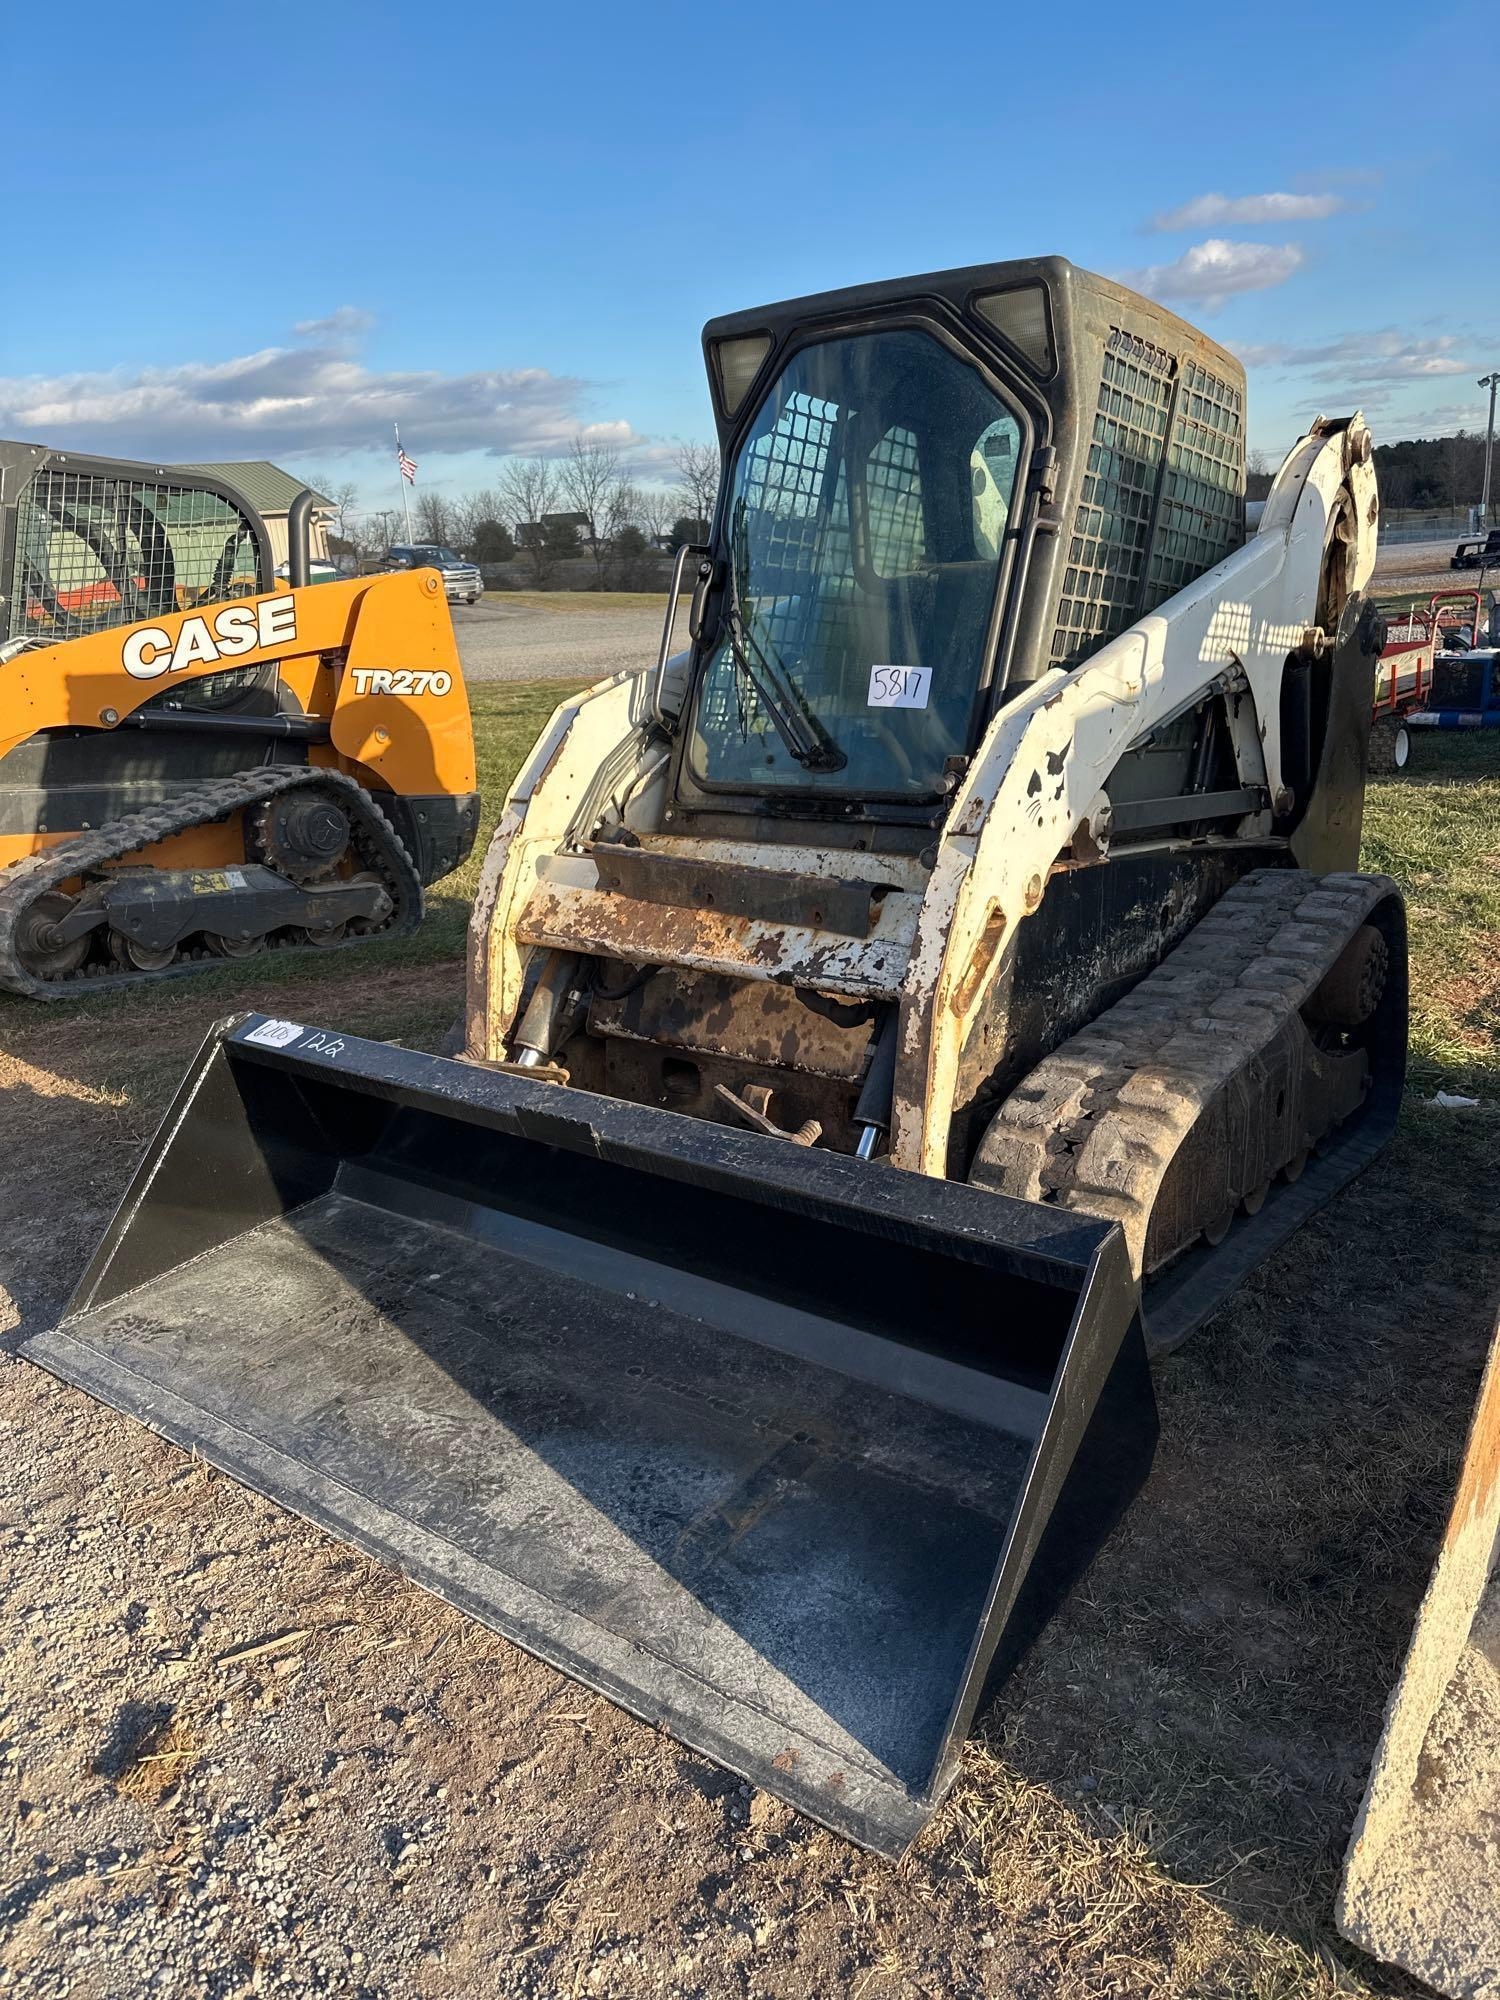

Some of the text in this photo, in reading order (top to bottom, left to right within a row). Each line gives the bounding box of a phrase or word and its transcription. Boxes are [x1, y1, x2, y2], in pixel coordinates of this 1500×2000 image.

[122, 594, 297, 680] CASE
[351, 668, 452, 697] TR270
[873, 668, 922, 700] 5817
